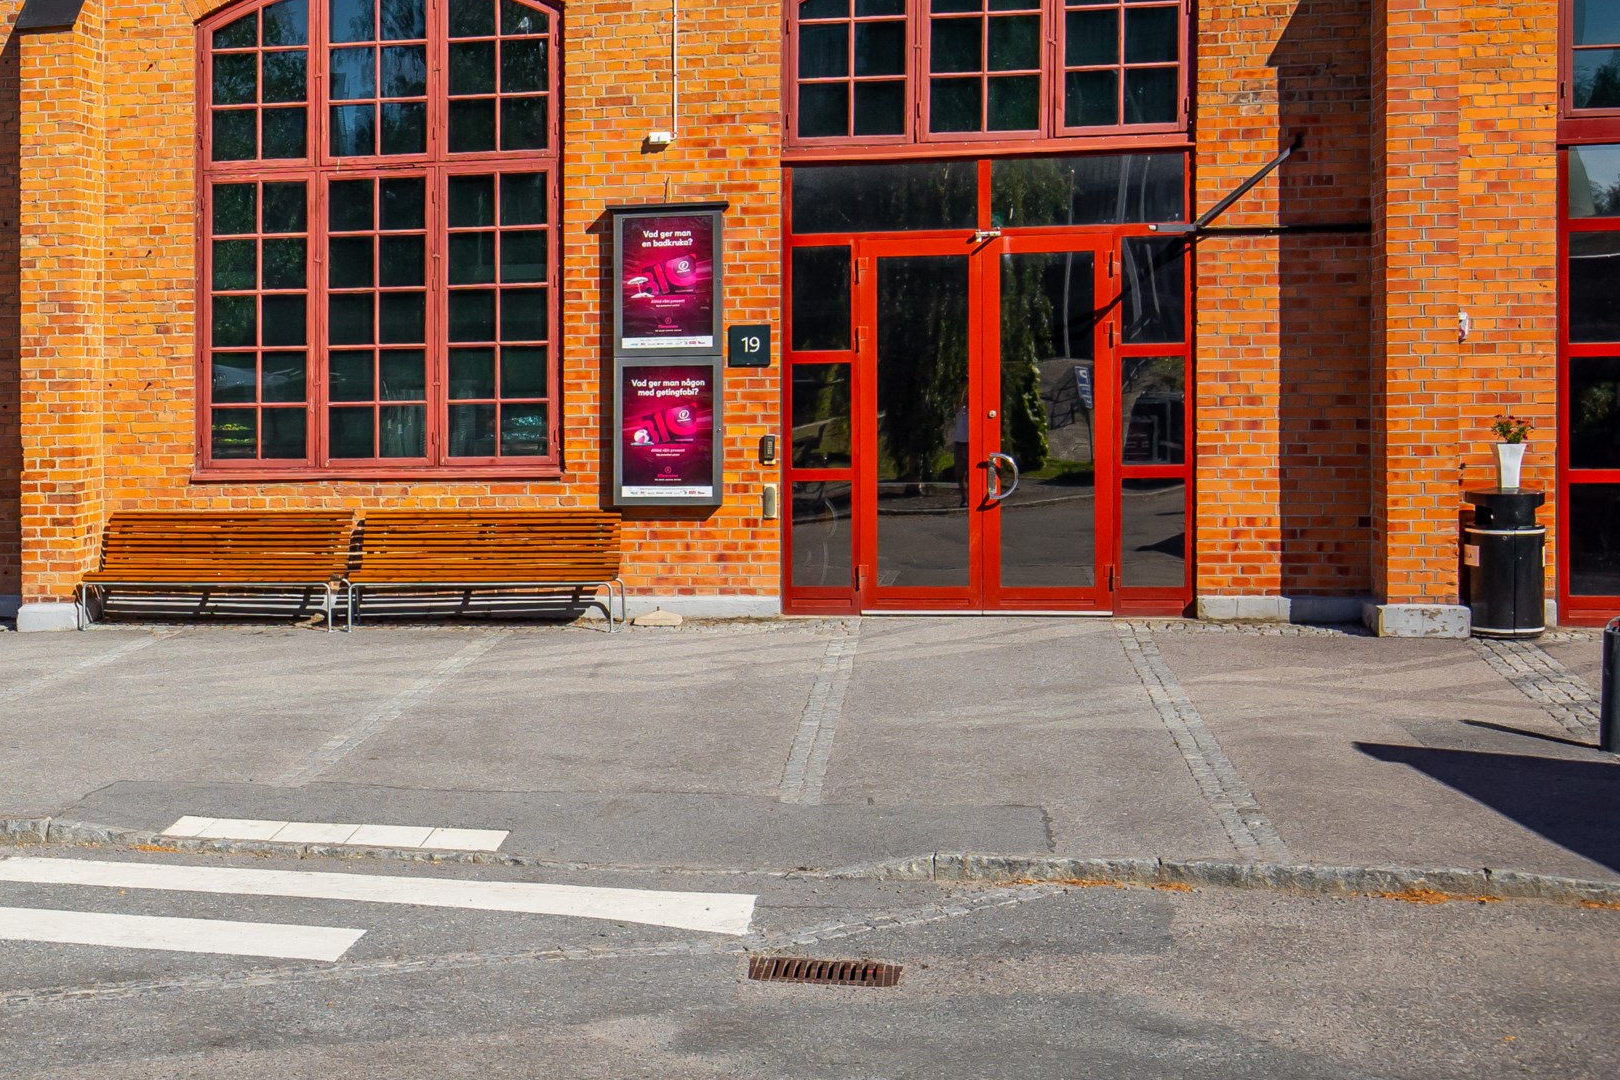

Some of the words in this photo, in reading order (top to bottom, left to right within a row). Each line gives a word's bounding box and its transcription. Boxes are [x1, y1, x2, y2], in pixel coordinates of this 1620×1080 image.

[643, 230, 658, 238] Vad
[660, 231, 673, 239] ger
[653, 238, 693, 247] badkruka?
[741, 336, 761, 353] 19
[631, 379, 647, 387] Vad
[648, 380, 661, 389] ger
[681, 378, 705, 388] någon
[637, 388, 655, 396] med
[656, 388, 699, 397] getingfobi?
